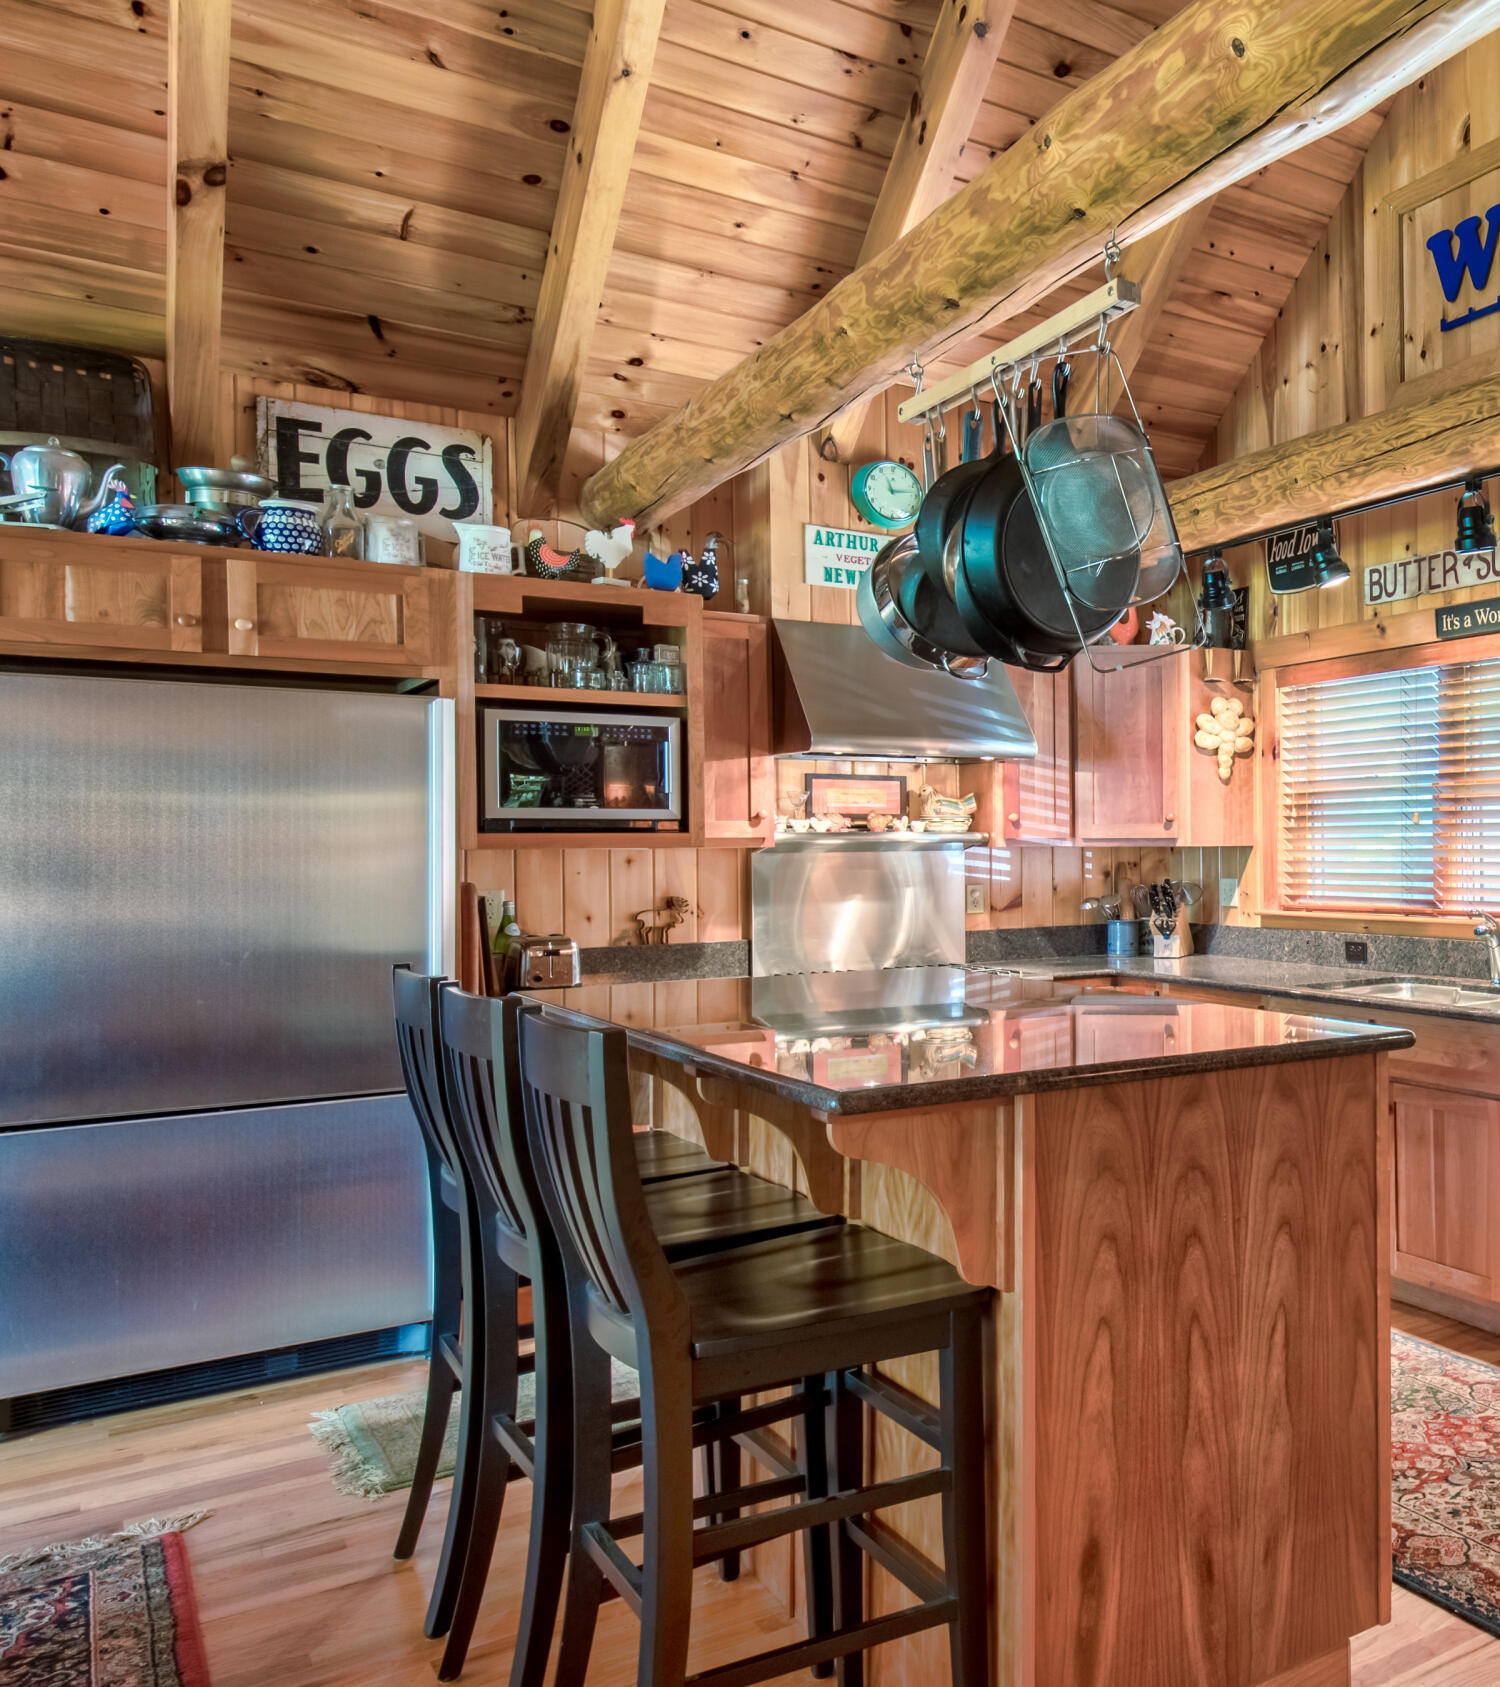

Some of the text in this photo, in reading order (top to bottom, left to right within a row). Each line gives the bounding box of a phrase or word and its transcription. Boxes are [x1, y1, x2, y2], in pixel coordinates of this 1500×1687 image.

[276, 416, 480, 520] EGGS
[813, 529, 879, 552] ARTHUR
[836, 554, 875, 566] VEGET
[1369, 551, 1460, 602] BUTTER
[1441, 613, 1460, 631] It's
[1463, 614, 1472, 629] a
